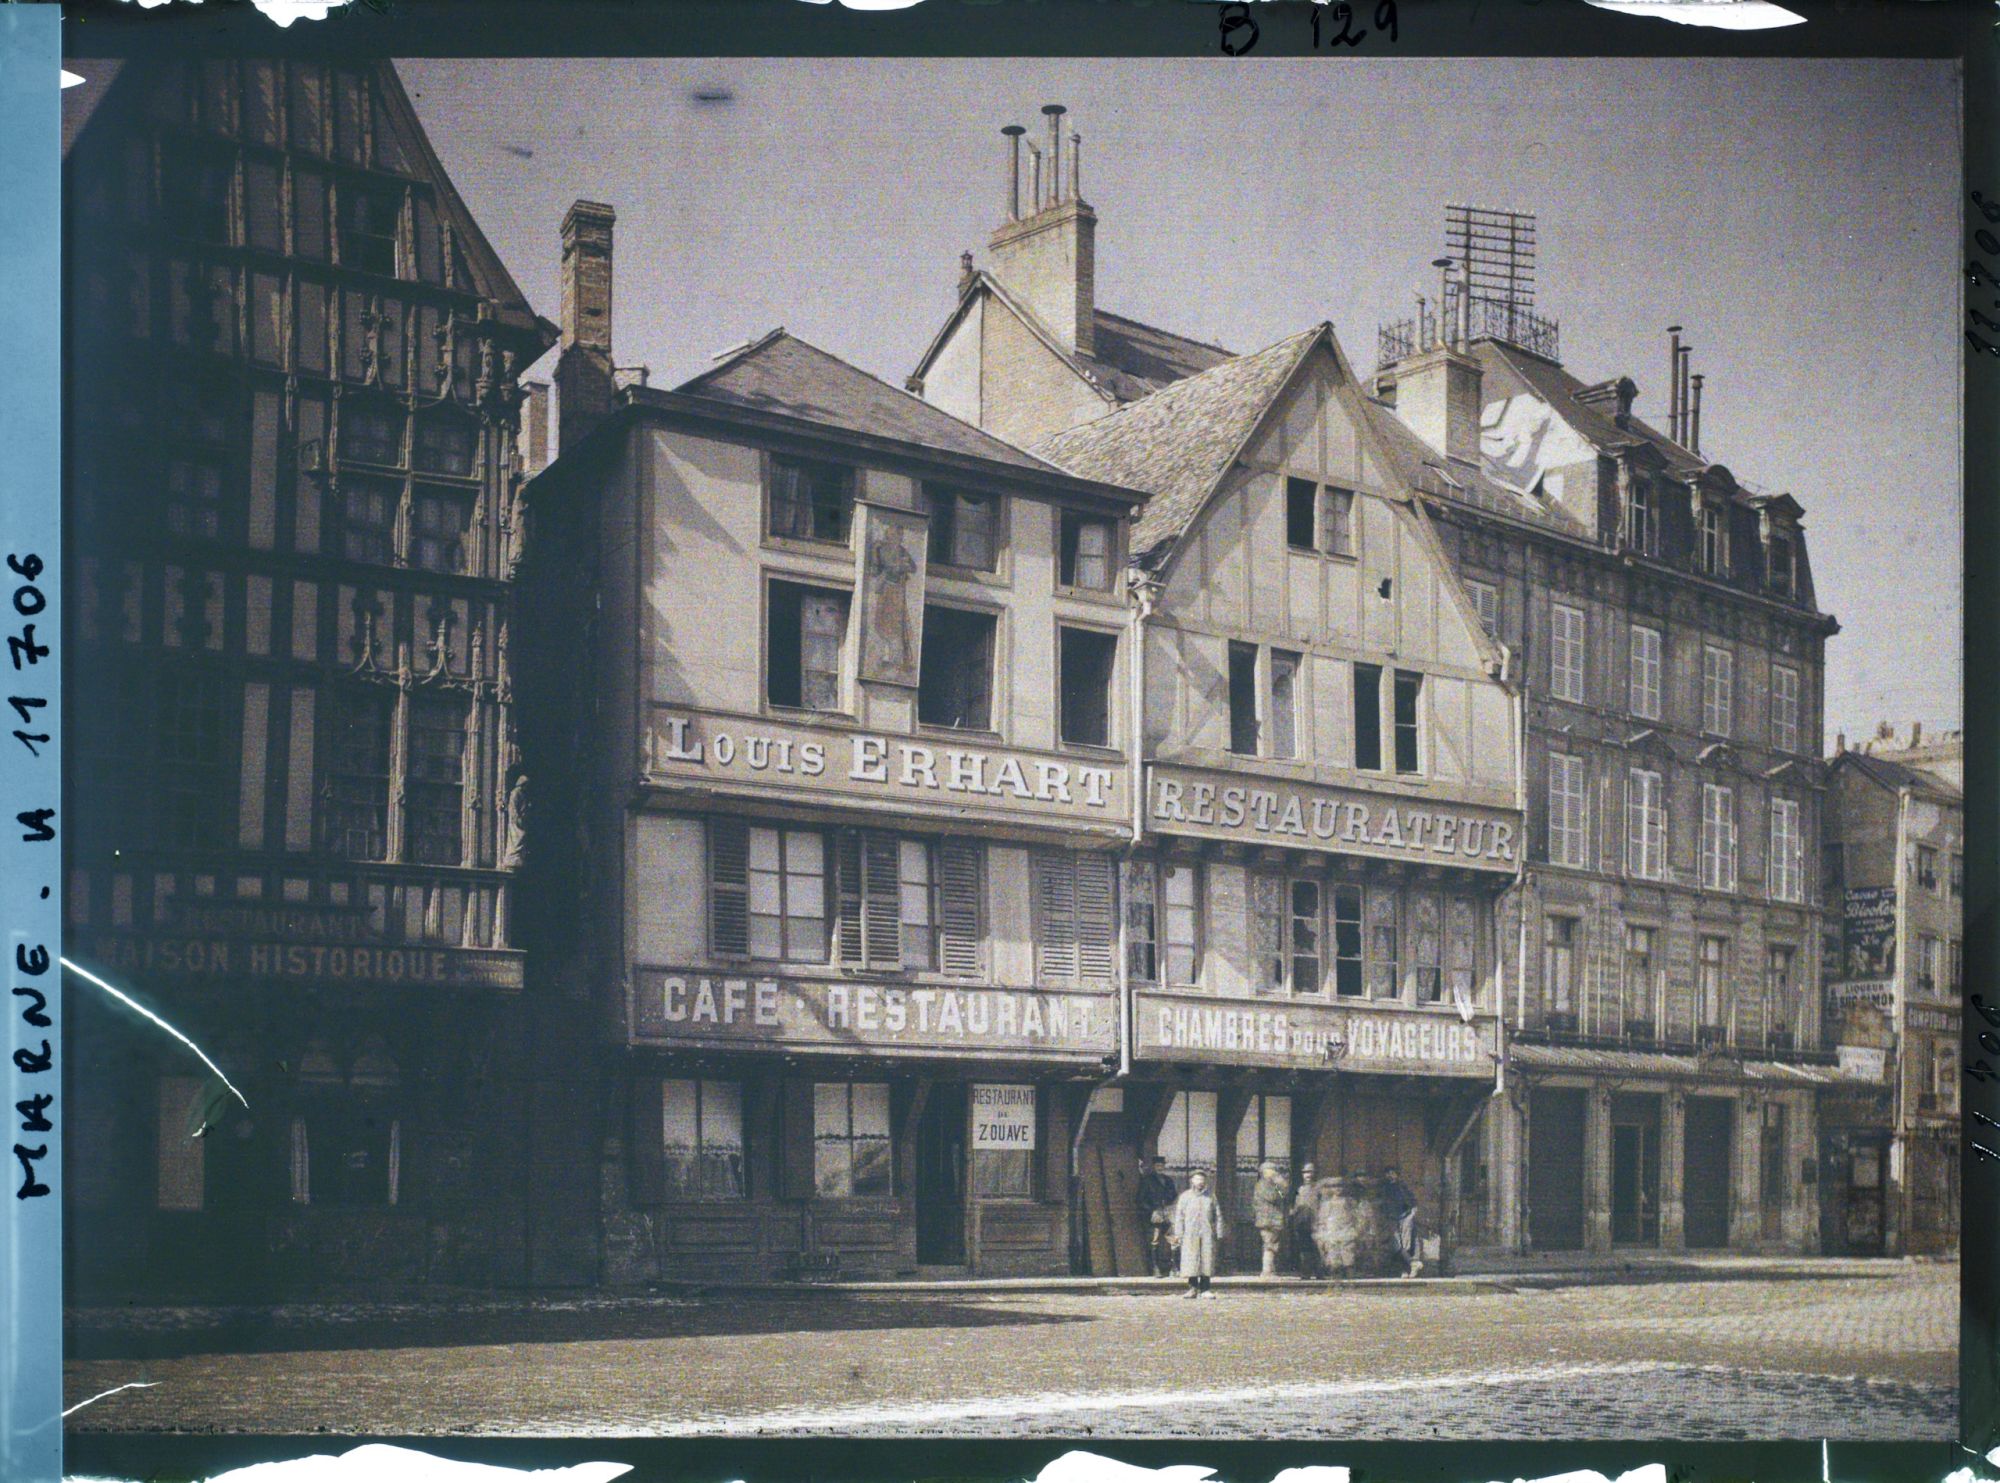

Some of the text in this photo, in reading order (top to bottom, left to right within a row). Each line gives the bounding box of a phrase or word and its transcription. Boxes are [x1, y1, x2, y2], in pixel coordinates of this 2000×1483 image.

[1311, 0, 1397, 49] 129
[665, 716, 1113, 808] LOUIS ERHART
[1154, 778, 1514, 861] RESTAURATEUR
[93, 937, 229, 972] MAISON
[251, 944, 446, 982] HISTORIQUE
[663, 976, 1095, 1039] CAFÉ RESTAURANT
[1157, 1006, 1288, 1053] CHAMBRES
[1346, 1018, 1476, 1063] VOYAGEURS
[14, 943, 54, 1201] MARNE
[973, 1088, 1034, 1105] RESTAURANT
[979, 1123, 1029, 1142] ZOUAVE
